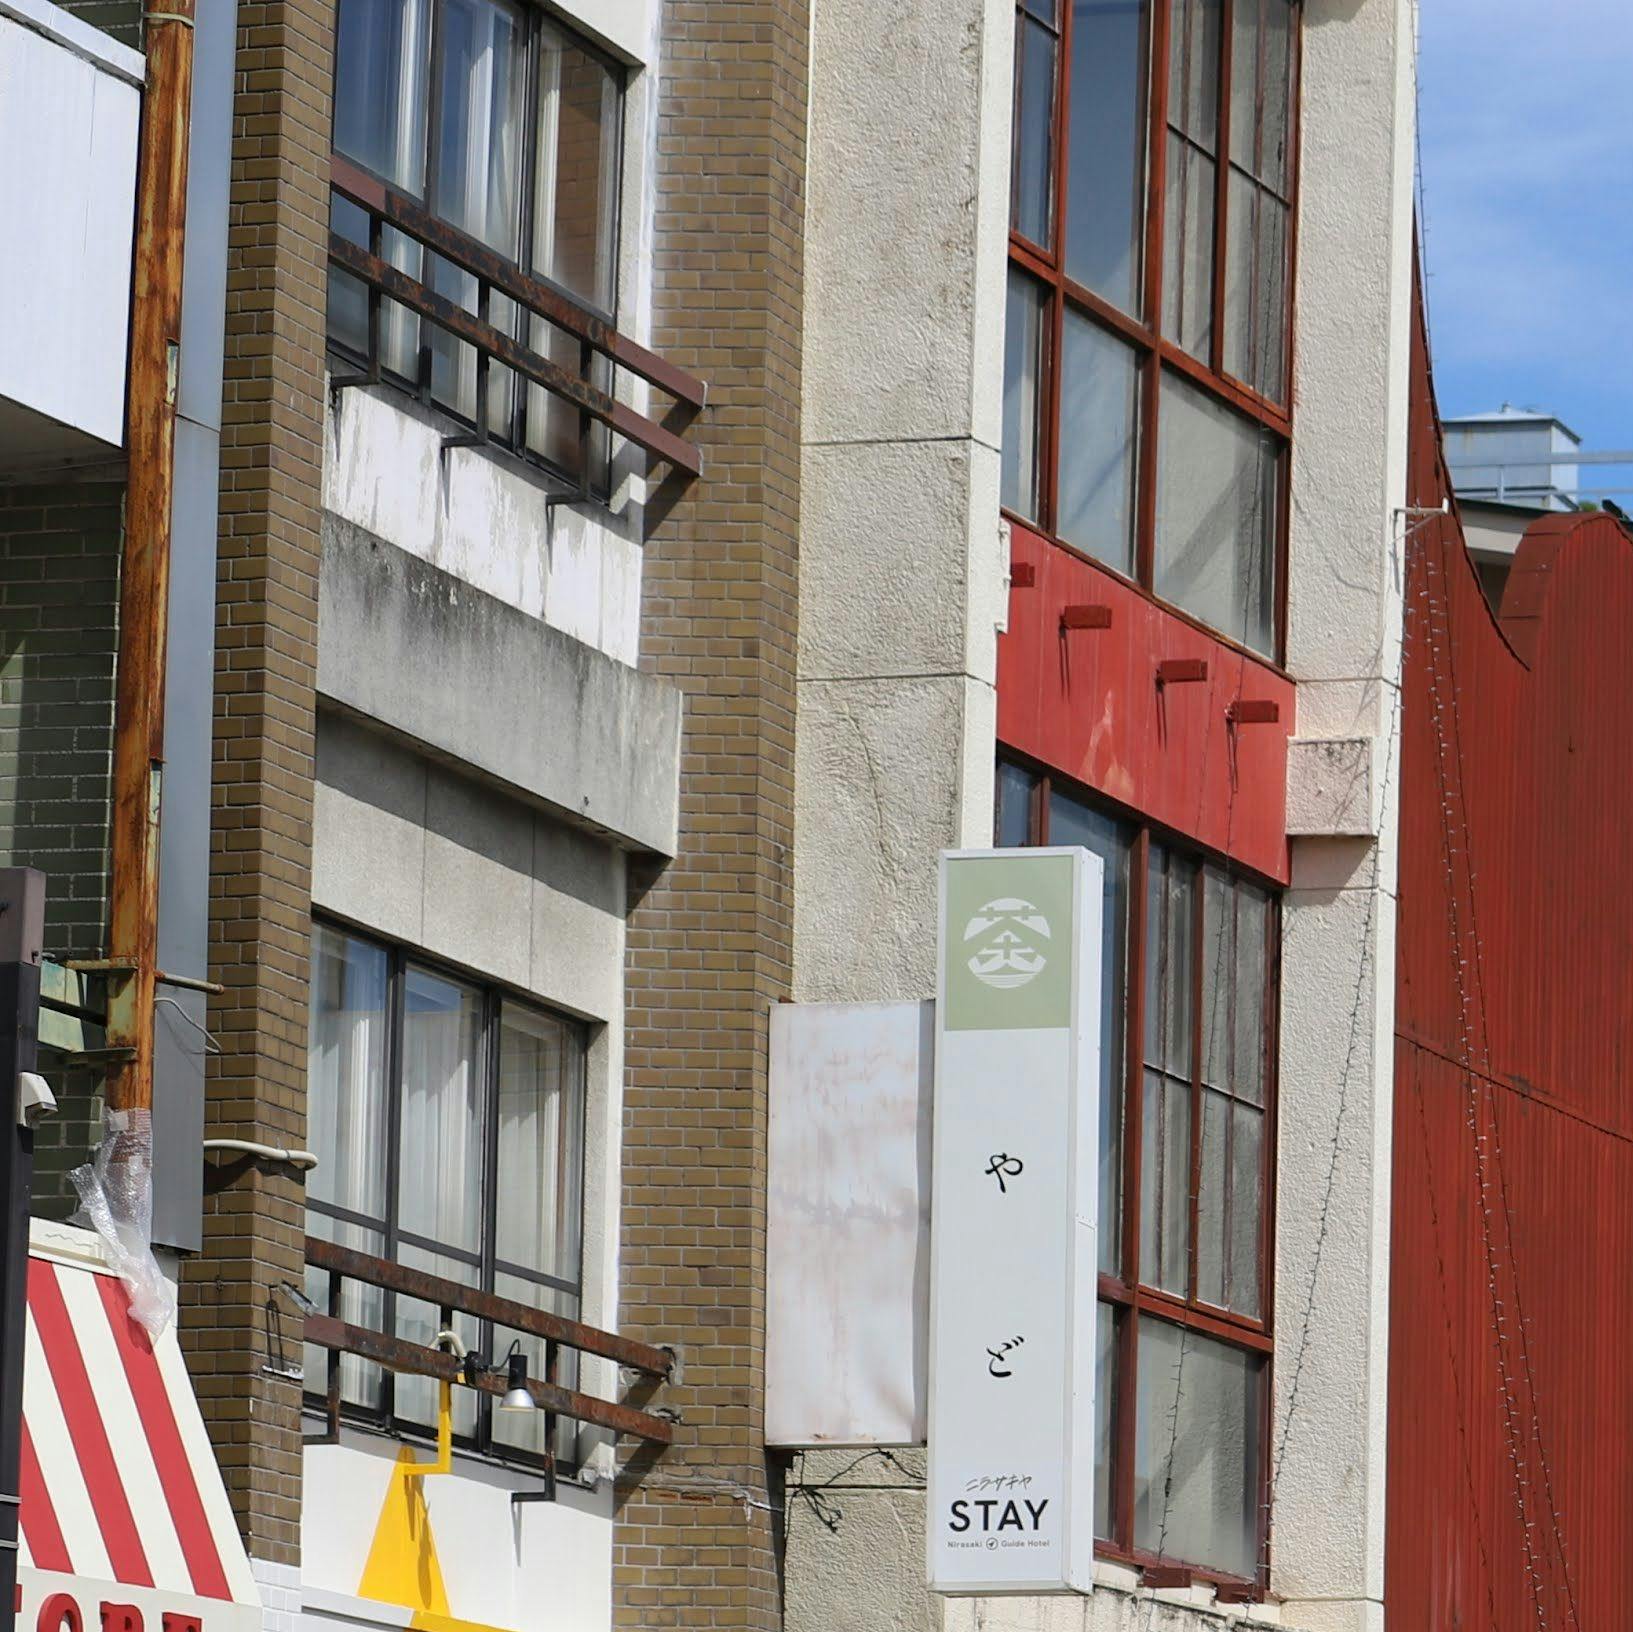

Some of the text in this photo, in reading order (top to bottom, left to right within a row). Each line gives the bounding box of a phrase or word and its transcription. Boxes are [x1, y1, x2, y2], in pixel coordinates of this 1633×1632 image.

[985, 1152, 1024, 1378] やど
[948, 1499, 1050, 1533] STAY
[947, 1539, 1050, 1549] Nirasaki Guide Hotel
